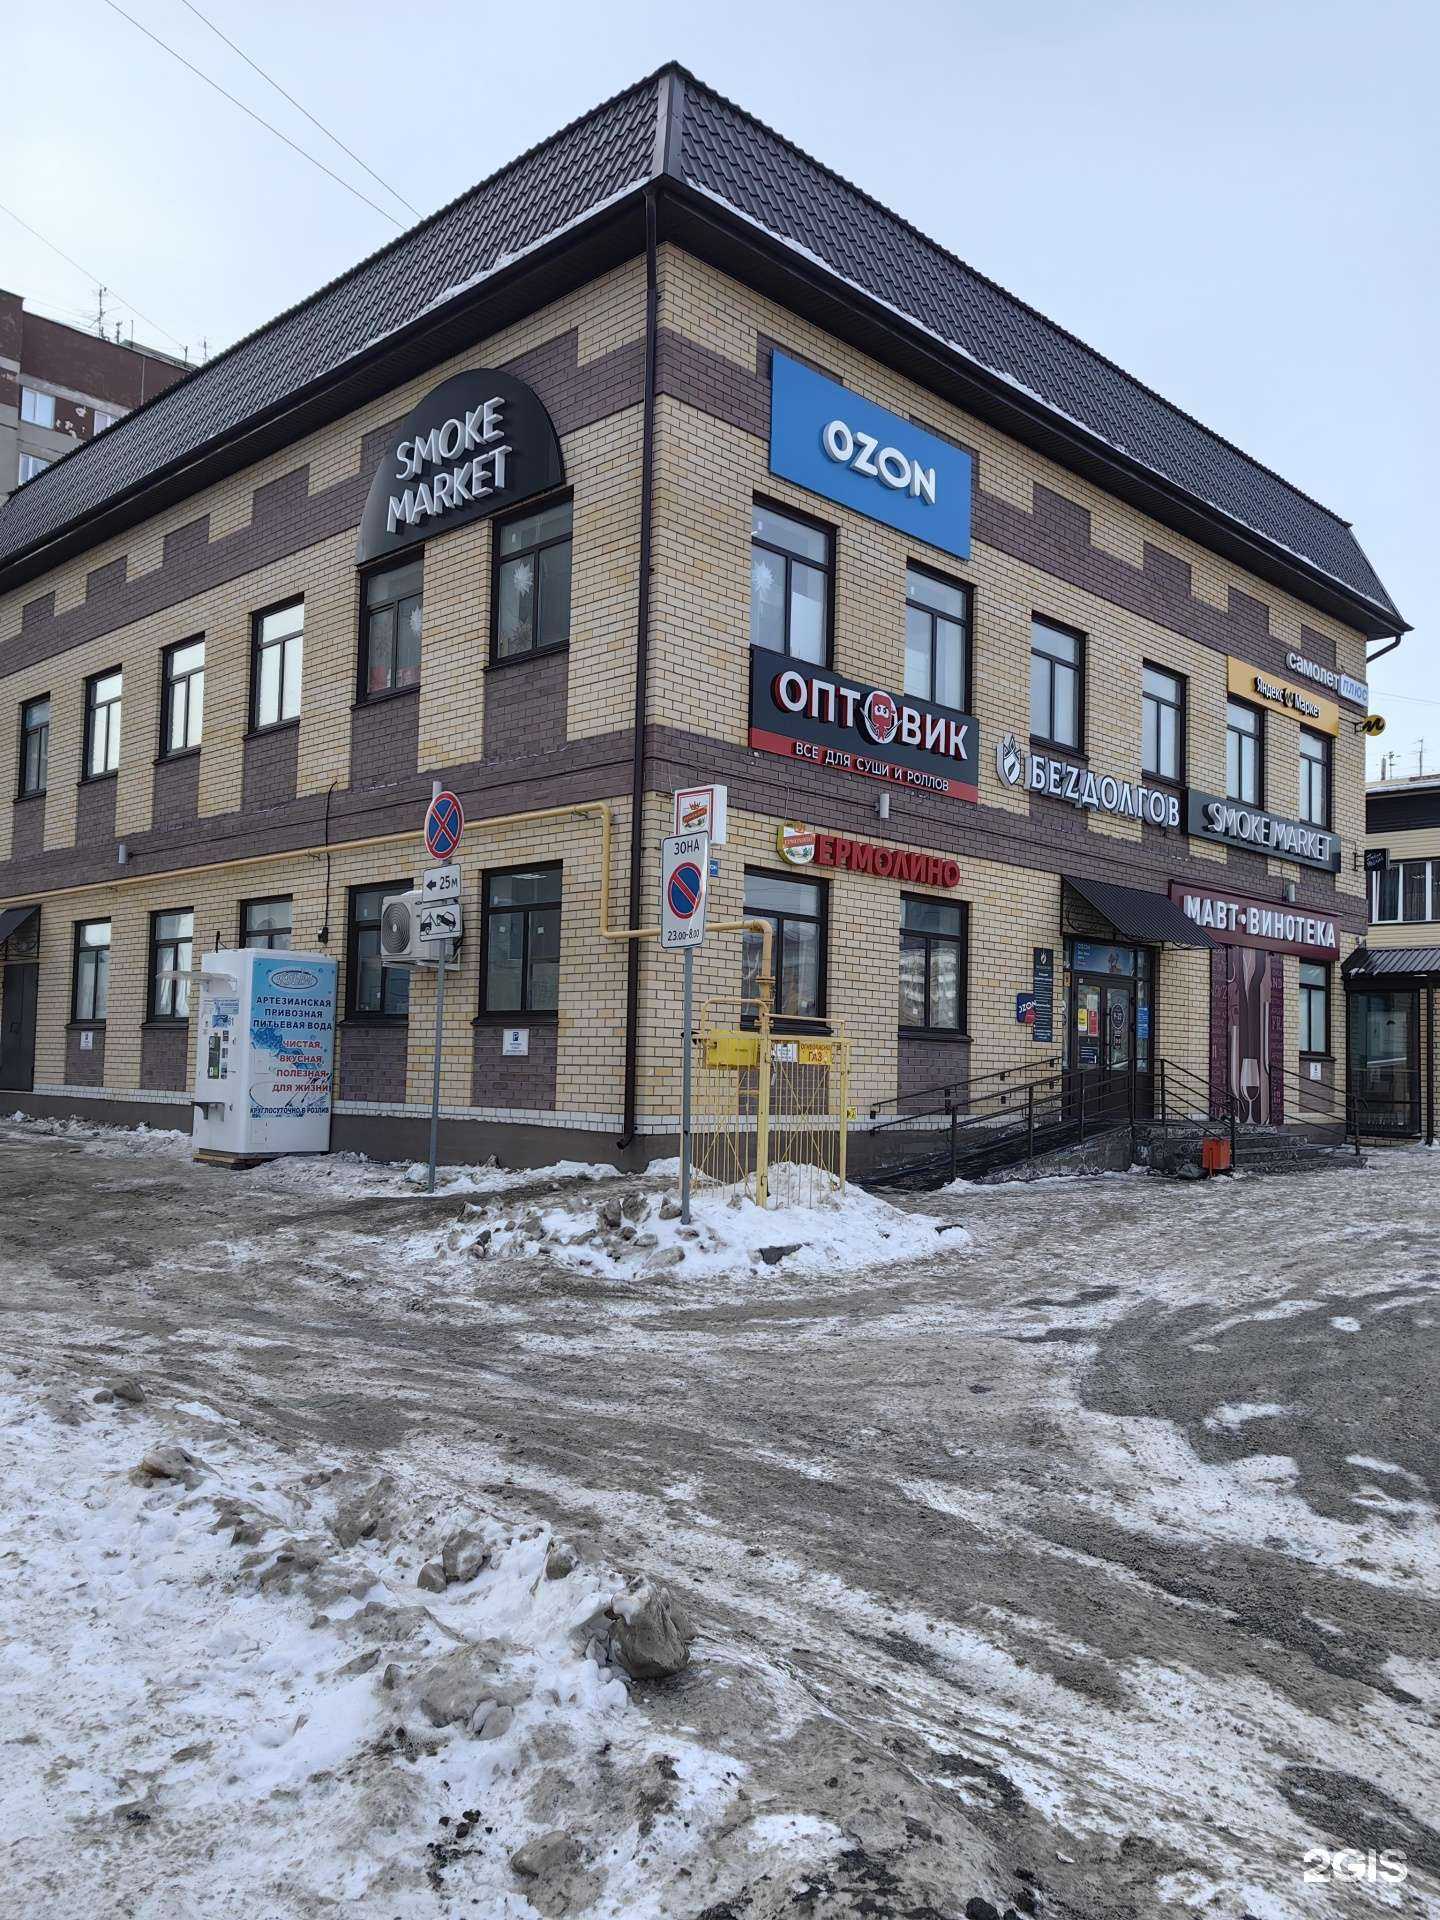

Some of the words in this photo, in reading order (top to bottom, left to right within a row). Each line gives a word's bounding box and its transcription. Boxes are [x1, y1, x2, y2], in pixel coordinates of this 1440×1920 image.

[396, 397, 505, 480] SMOKE
[822, 420, 936, 505] OZON
[387, 445, 512, 533] MARKET
[1256, 675, 1284, 702] Яндекс
[1286, 652, 1339, 691] самолет
[772, 671, 968, 760] ОПТОВИК
[795, 741, 819, 759] ВСЕ
[825, 749, 851, 767] ДЛЯ
[856, 758, 889, 777] СУШИ
[894, 770, 903, 780] И
[907, 771, 949, 791] РОЛЛОВ
[1025, 755, 1180, 827] БЕZДОЛГОВ
[673, 839, 700, 856] ЗОНА
[1207, 803, 1270, 846] SMOKE
[1269, 821, 1332, 861] MARKET
[816, 834, 961, 887] ЕРМОЛИНО
[256, 997, 331, 1007] АРТЕЗИАНСКАЯ
[265, 1008, 323, 1018] ПРИВОЗНАЯ
[253, 1020, 305, 1030] ПИТЬЕВАЯ
[307, 1022, 332, 1032] ВОДА
[809, 1051, 823, 1062] ГАЗ
[272, 1084, 293, 1093] ДЛЯ
[249, 1106, 300, 1115] КРУГЛОСУТОЧНО
